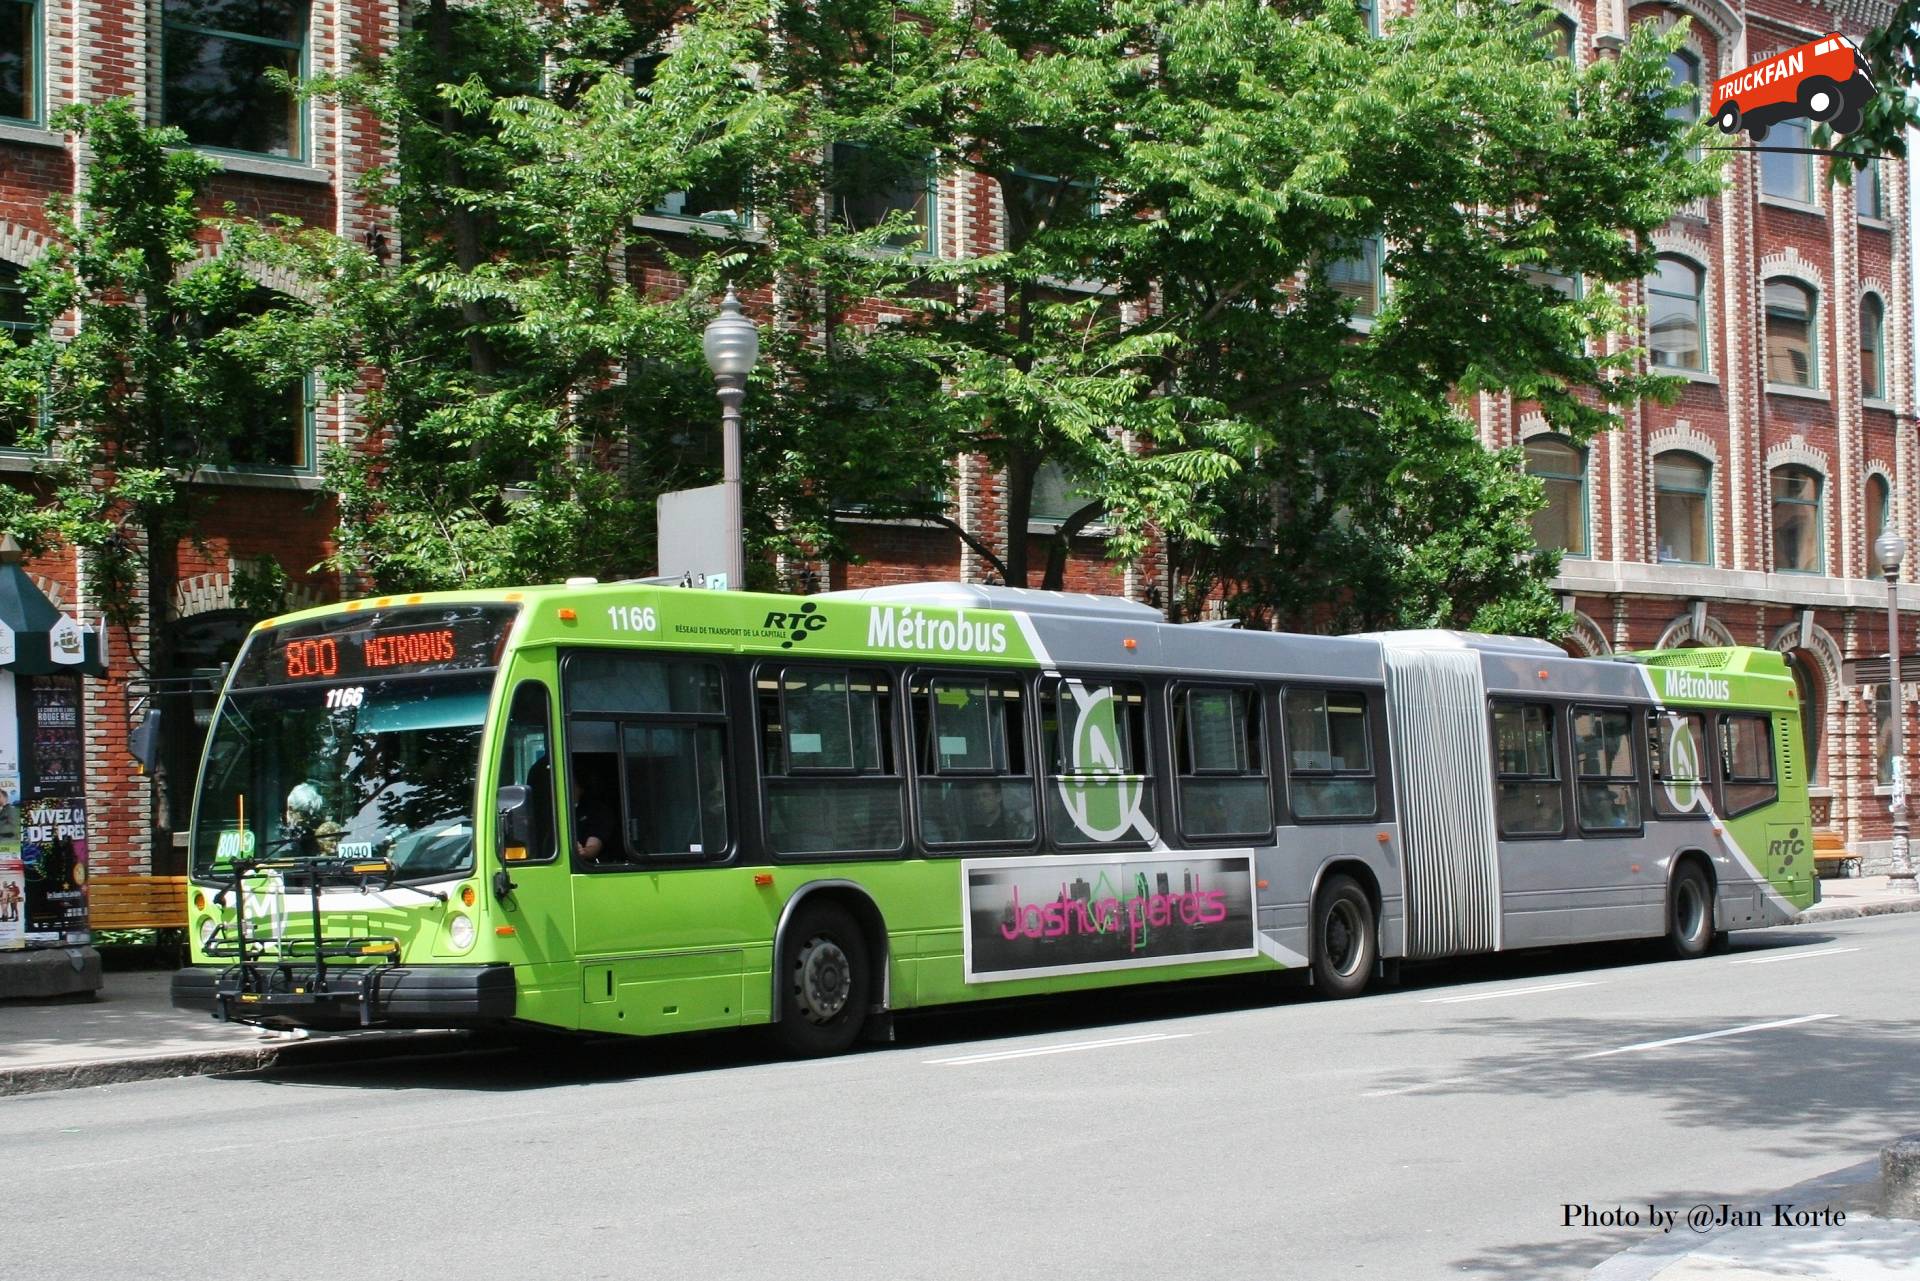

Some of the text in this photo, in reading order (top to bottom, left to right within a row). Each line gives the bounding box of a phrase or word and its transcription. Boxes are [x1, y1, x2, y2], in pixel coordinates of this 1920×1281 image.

[607, 606, 656, 632] 1166
[764, 612, 827, 631] RTC
[867, 605, 1007, 653] Métrobus
[675, 624, 786, 639] RÉSEAU DE TRANSPORT DE LA CAPITALE
[287, 631, 455, 678] 800 METROBUS
[1665, 668, 1730, 701] Métrobus
[326, 687, 365, 708] 1166
[30, 808, 72, 825] VIVEZ
[28, 825, 53, 842] DE
[218, 833, 240, 858] 800
[341, 844, 369, 859] 2040
[1768, 839, 1805, 857] RTC
